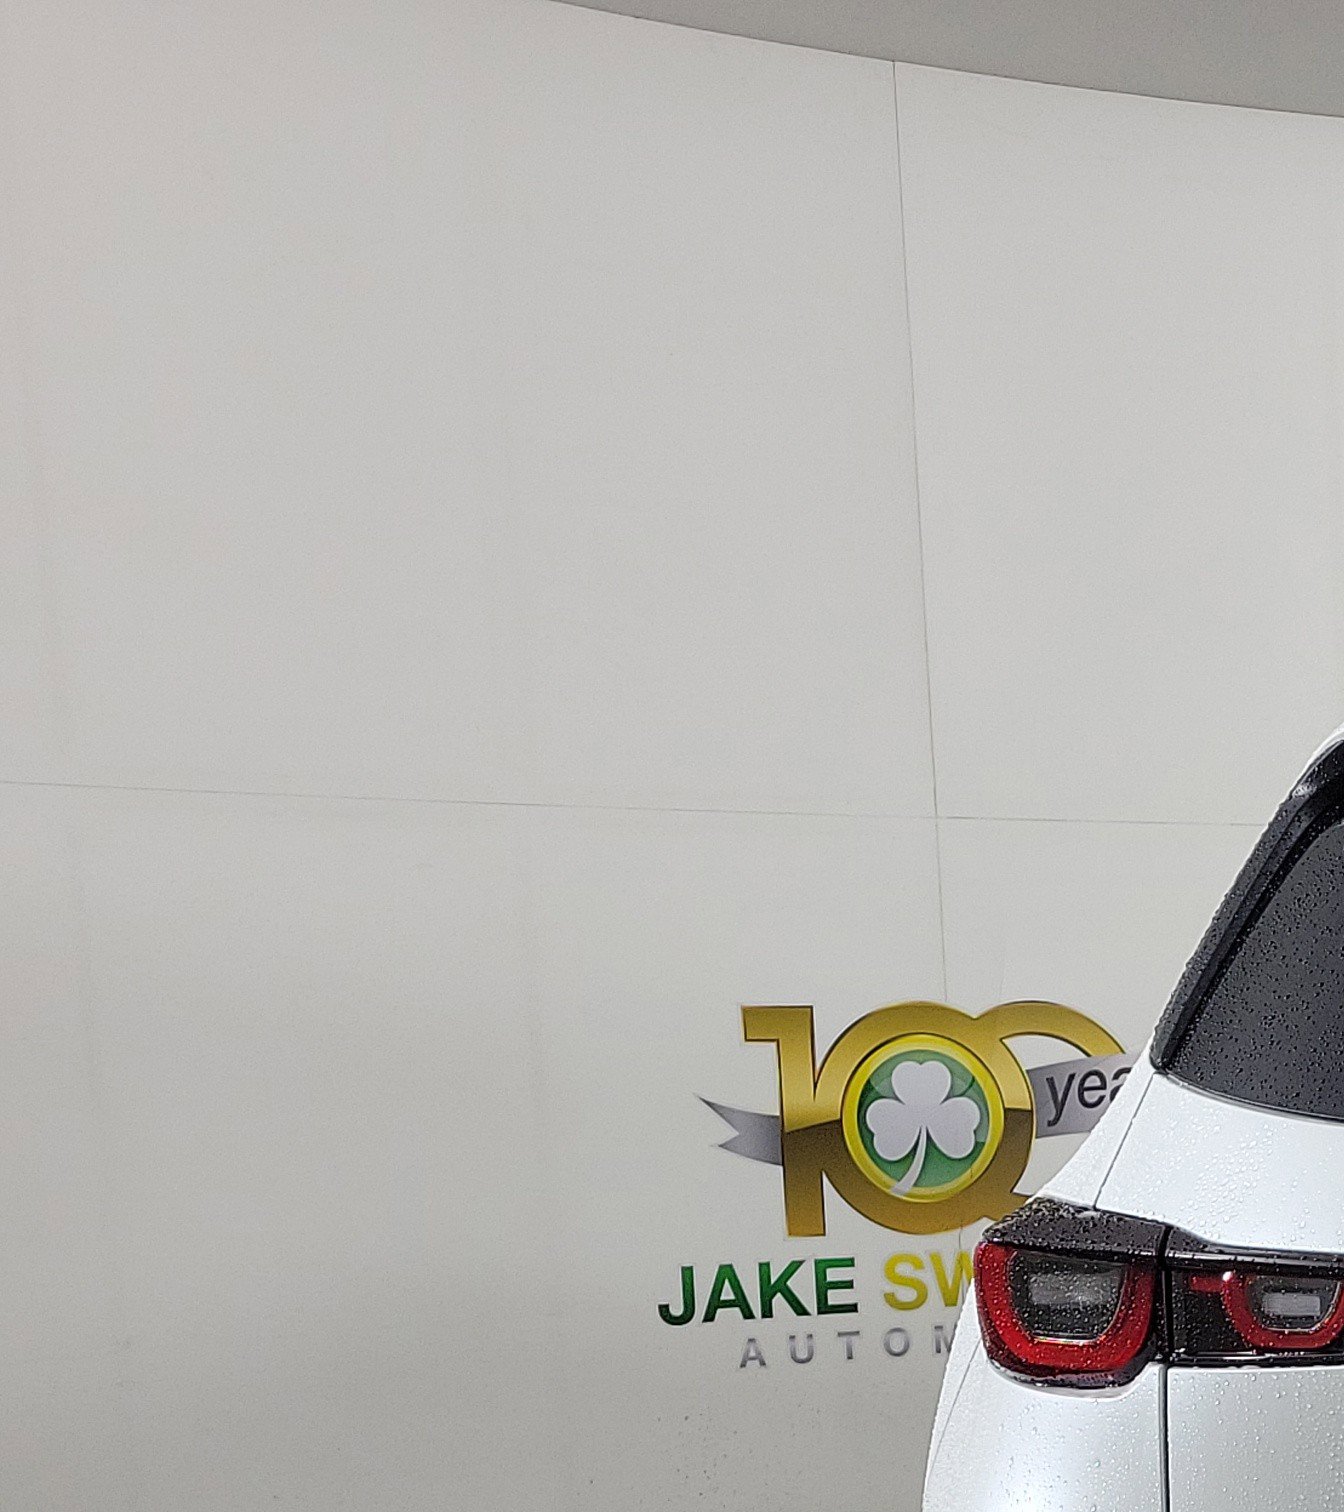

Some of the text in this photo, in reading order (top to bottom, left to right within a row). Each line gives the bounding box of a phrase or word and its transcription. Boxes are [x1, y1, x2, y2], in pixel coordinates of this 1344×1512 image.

[740, 1000, 1126, 1238] 100
[657, 1256, 859, 1326] JAKE
[739, 1323, 958, 1369] AUTOM
